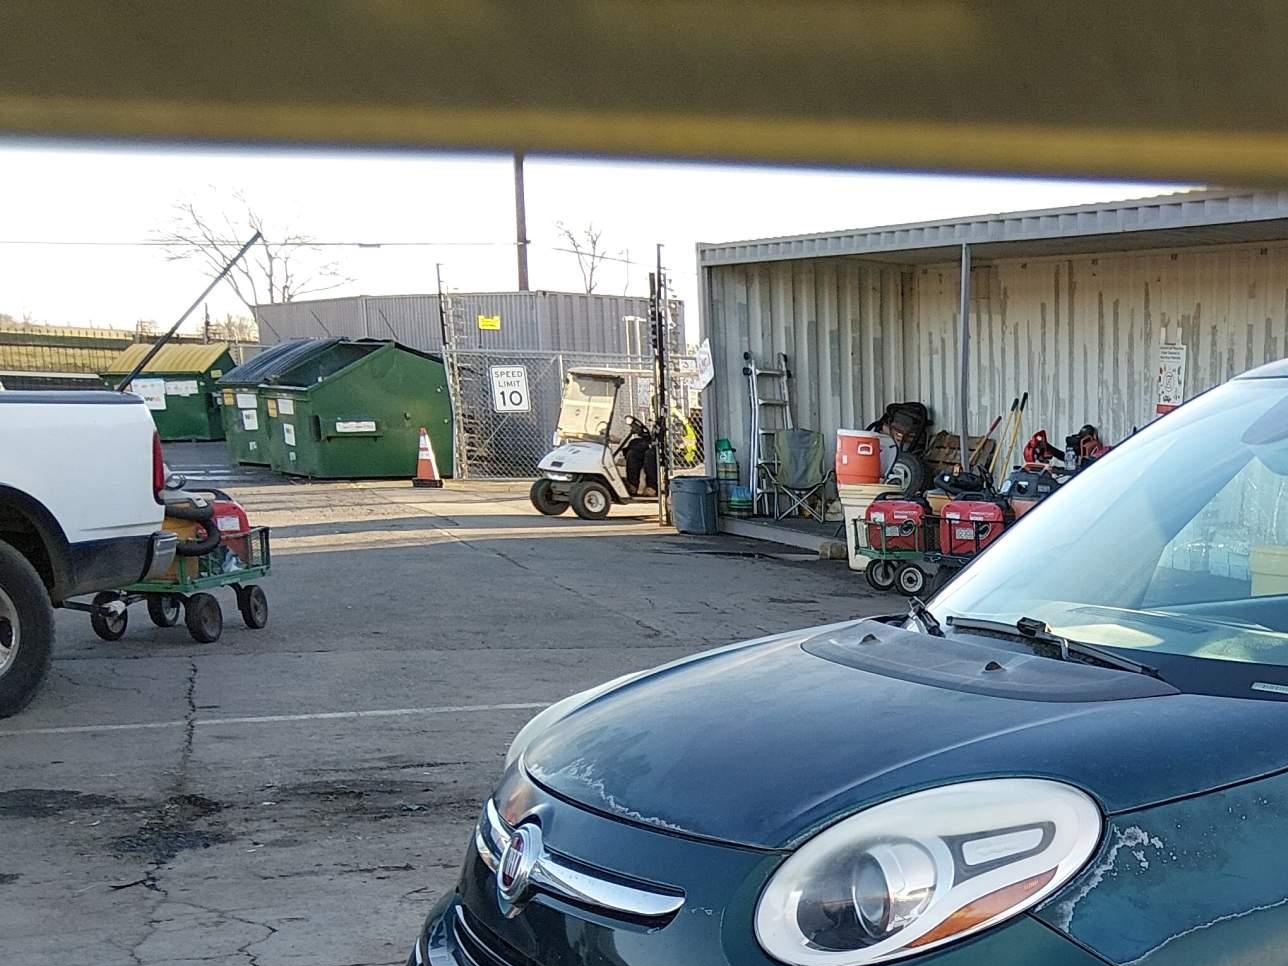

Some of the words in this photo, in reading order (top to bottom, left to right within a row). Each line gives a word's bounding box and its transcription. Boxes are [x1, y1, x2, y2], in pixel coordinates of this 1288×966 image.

[494, 370, 523, 378] SPEED
[498, 380, 521, 388] LIMIT
[499, 390, 523, 407] 10
